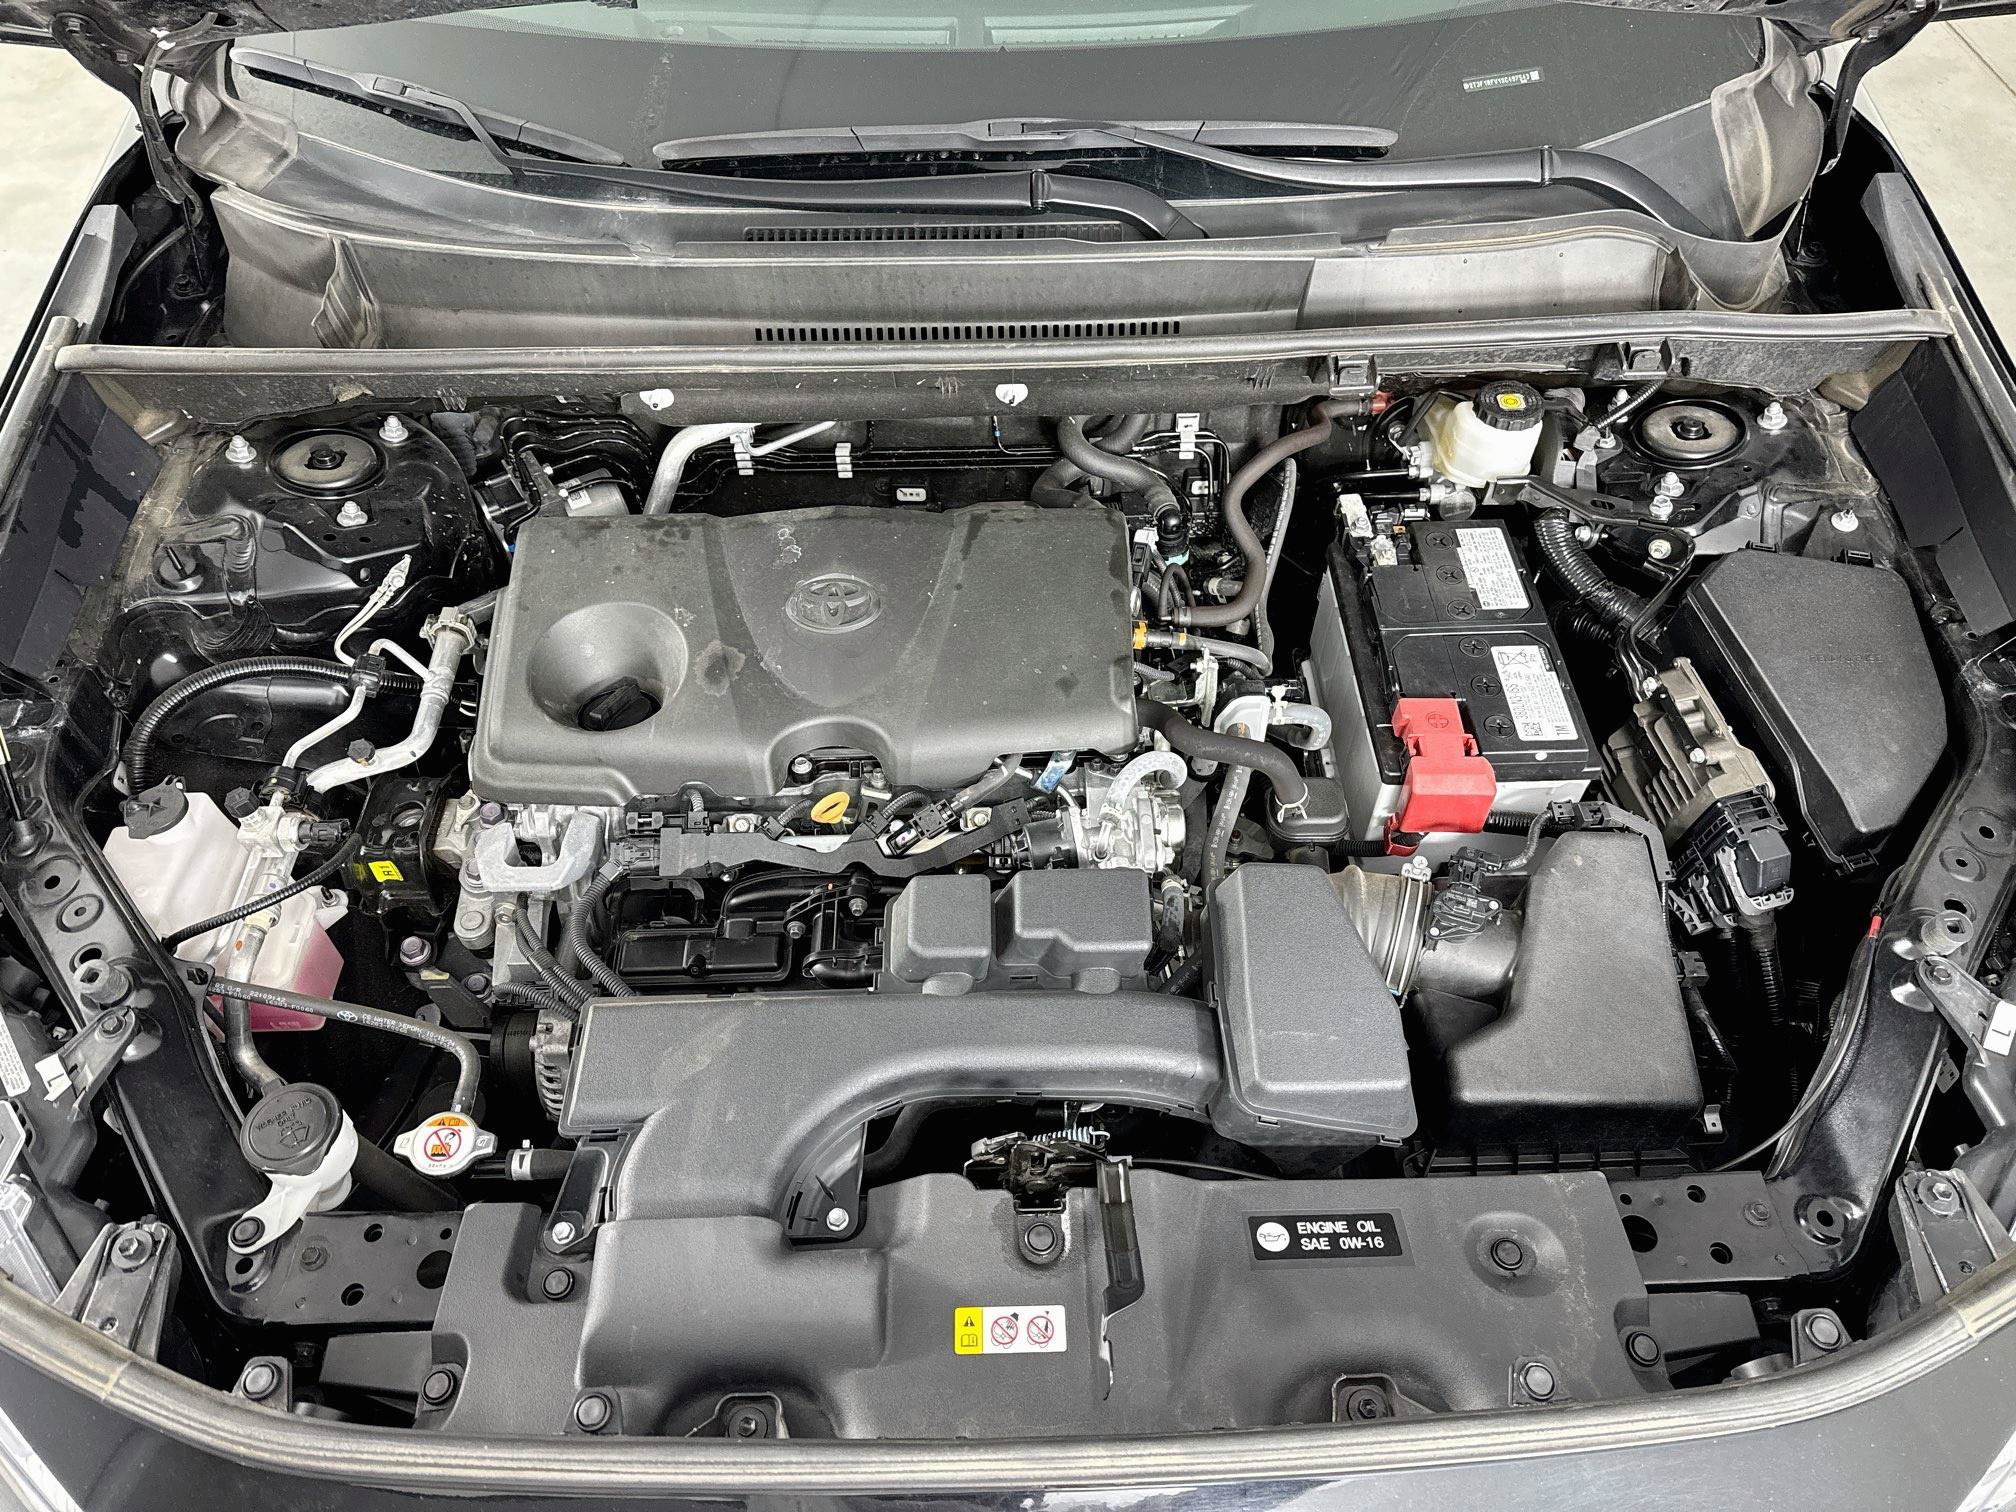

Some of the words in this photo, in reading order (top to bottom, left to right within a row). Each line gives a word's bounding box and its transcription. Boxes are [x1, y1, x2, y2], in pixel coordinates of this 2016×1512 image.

[373, 1015, 396, 1026] WATER
[1296, 1221, 1349, 1234] ENGINE
[1356, 1220, 1381, 1233] OIL
[1300, 1237, 1331, 1250] SAE
[1339, 1236, 1385, 1250] 0W-16
